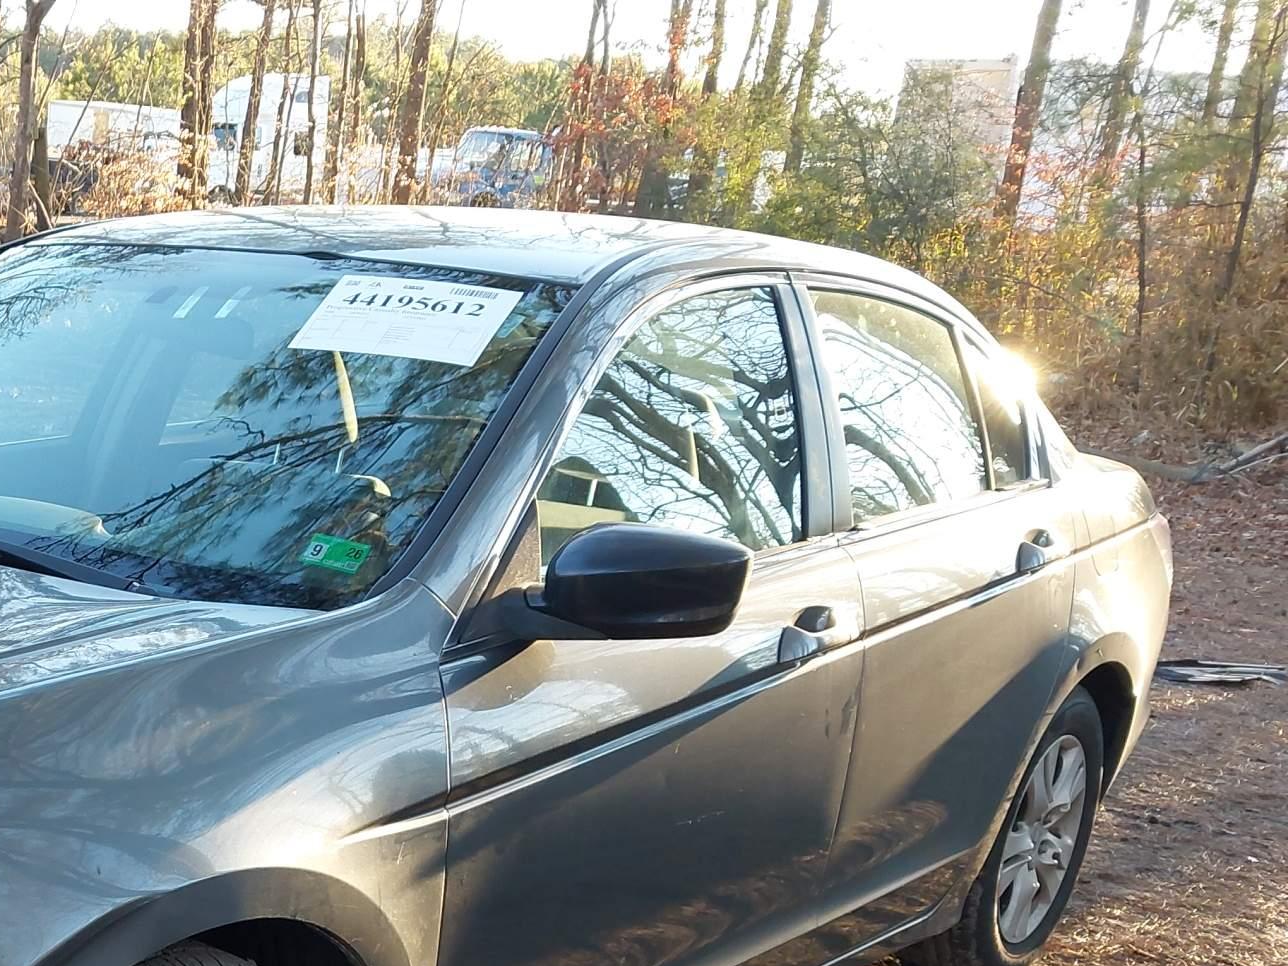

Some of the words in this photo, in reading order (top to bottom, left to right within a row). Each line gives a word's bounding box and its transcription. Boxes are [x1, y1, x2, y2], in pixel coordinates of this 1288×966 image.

[342, 291, 487, 317] 44195612
[310, 544, 323, 557] 9
[345, 547, 363, 560] 26
